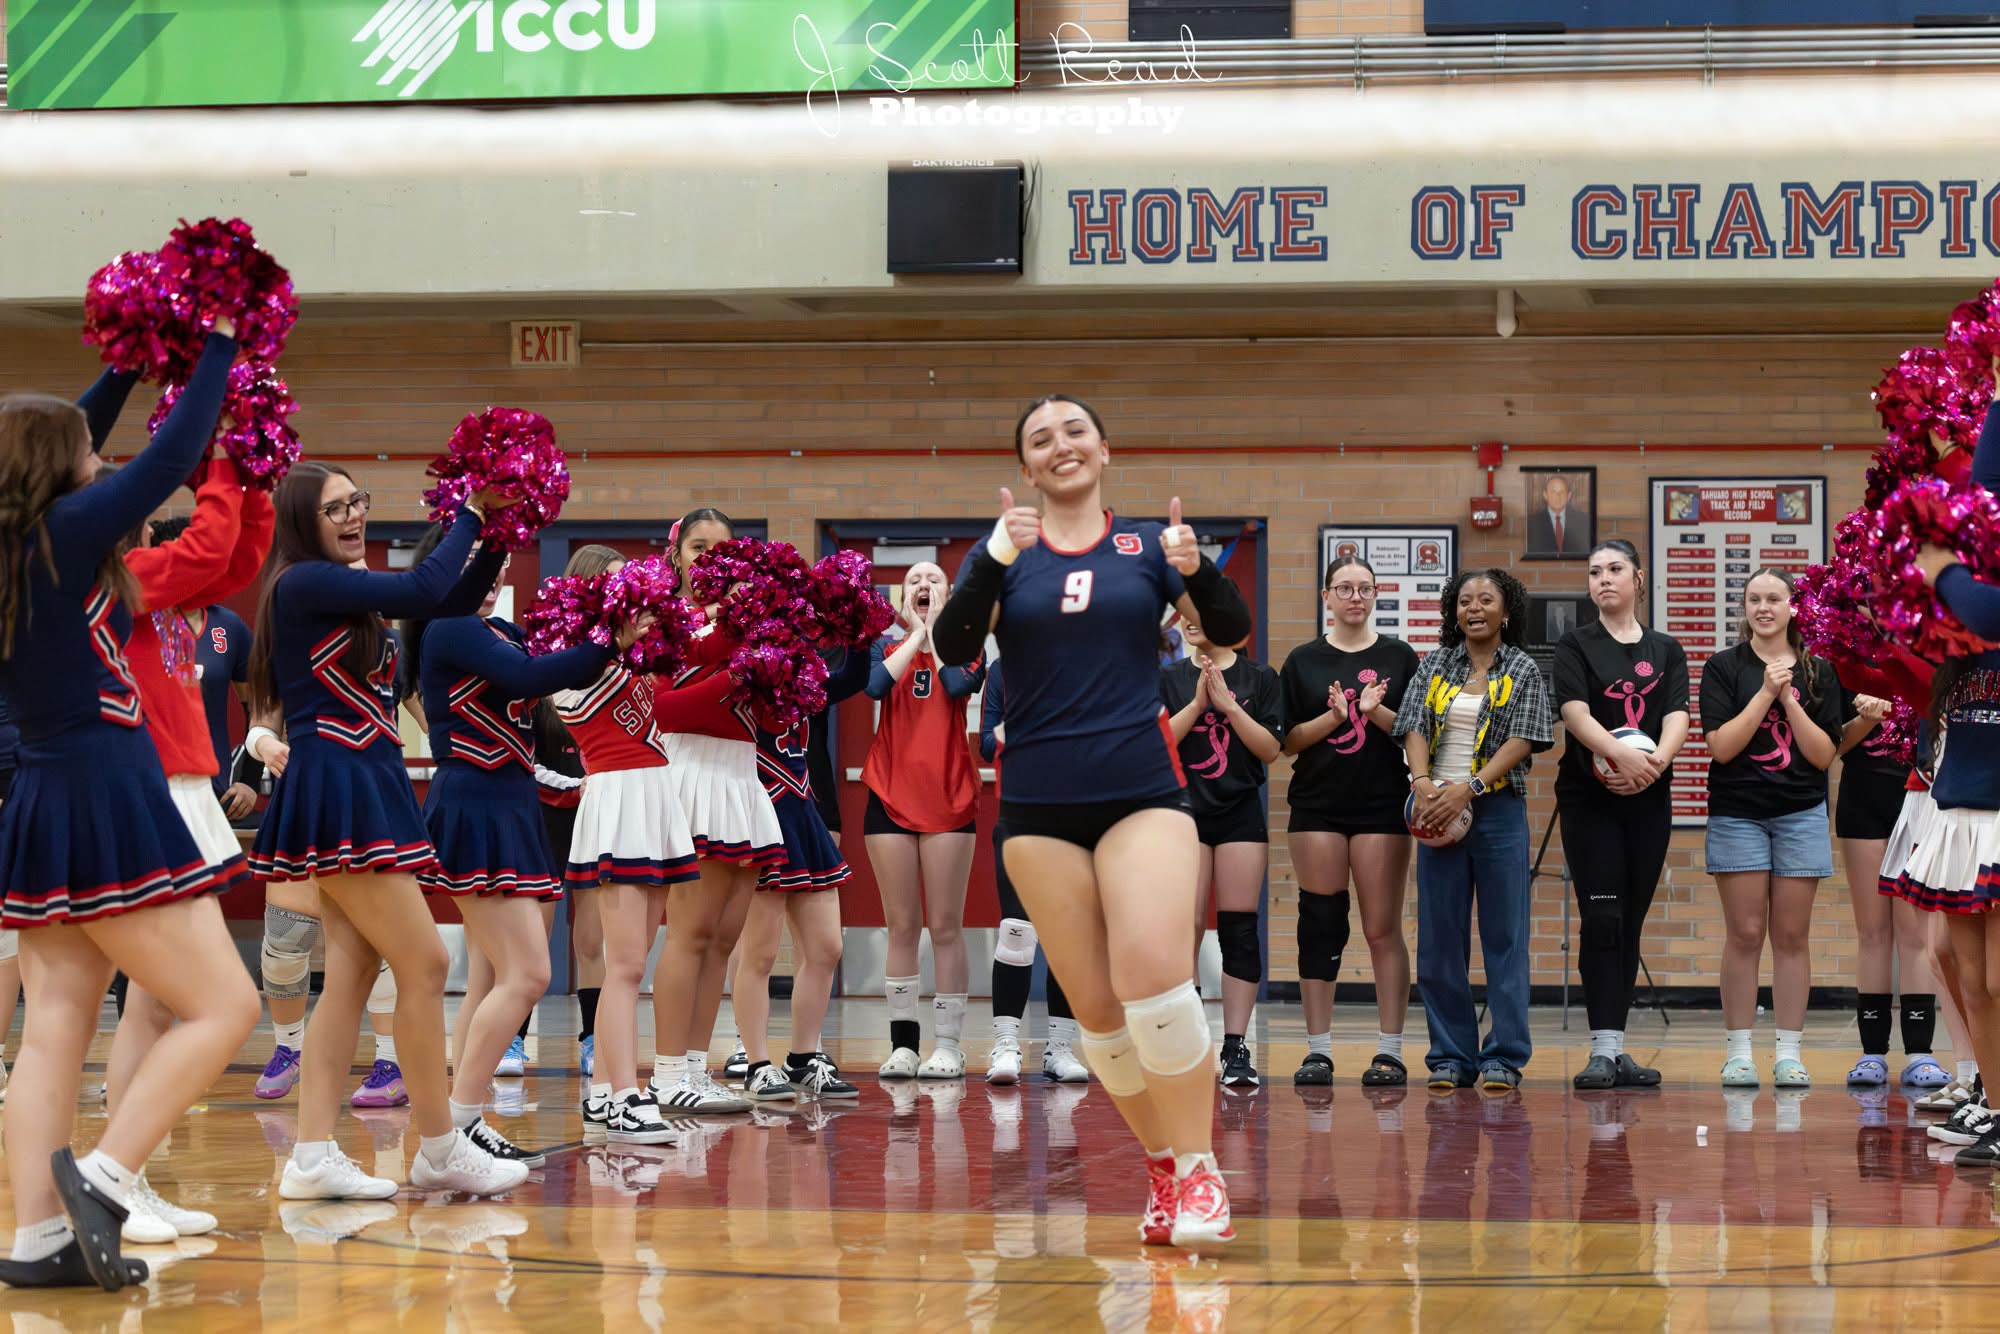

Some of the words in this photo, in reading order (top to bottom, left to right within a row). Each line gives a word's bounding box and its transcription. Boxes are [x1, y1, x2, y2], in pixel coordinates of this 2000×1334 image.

[476, 0, 656, 52] ICCU
[1069, 186, 1328, 265] HOME
[1411, 184, 1525, 261] OF
[521, 326, 571, 361] EXIT
[1711, 501, 1730, 510] TRACK
[1733, 500, 1746, 510] AND
[1749, 500, 1766, 510] FIELD
[1750, 489, 1774, 499] SCHOOL
[1724, 510, 1752, 520] RECORDS
[1061, 570, 1093, 614] 9
[211, 627, 228, 653] S
[912, 668, 932, 698] 9
